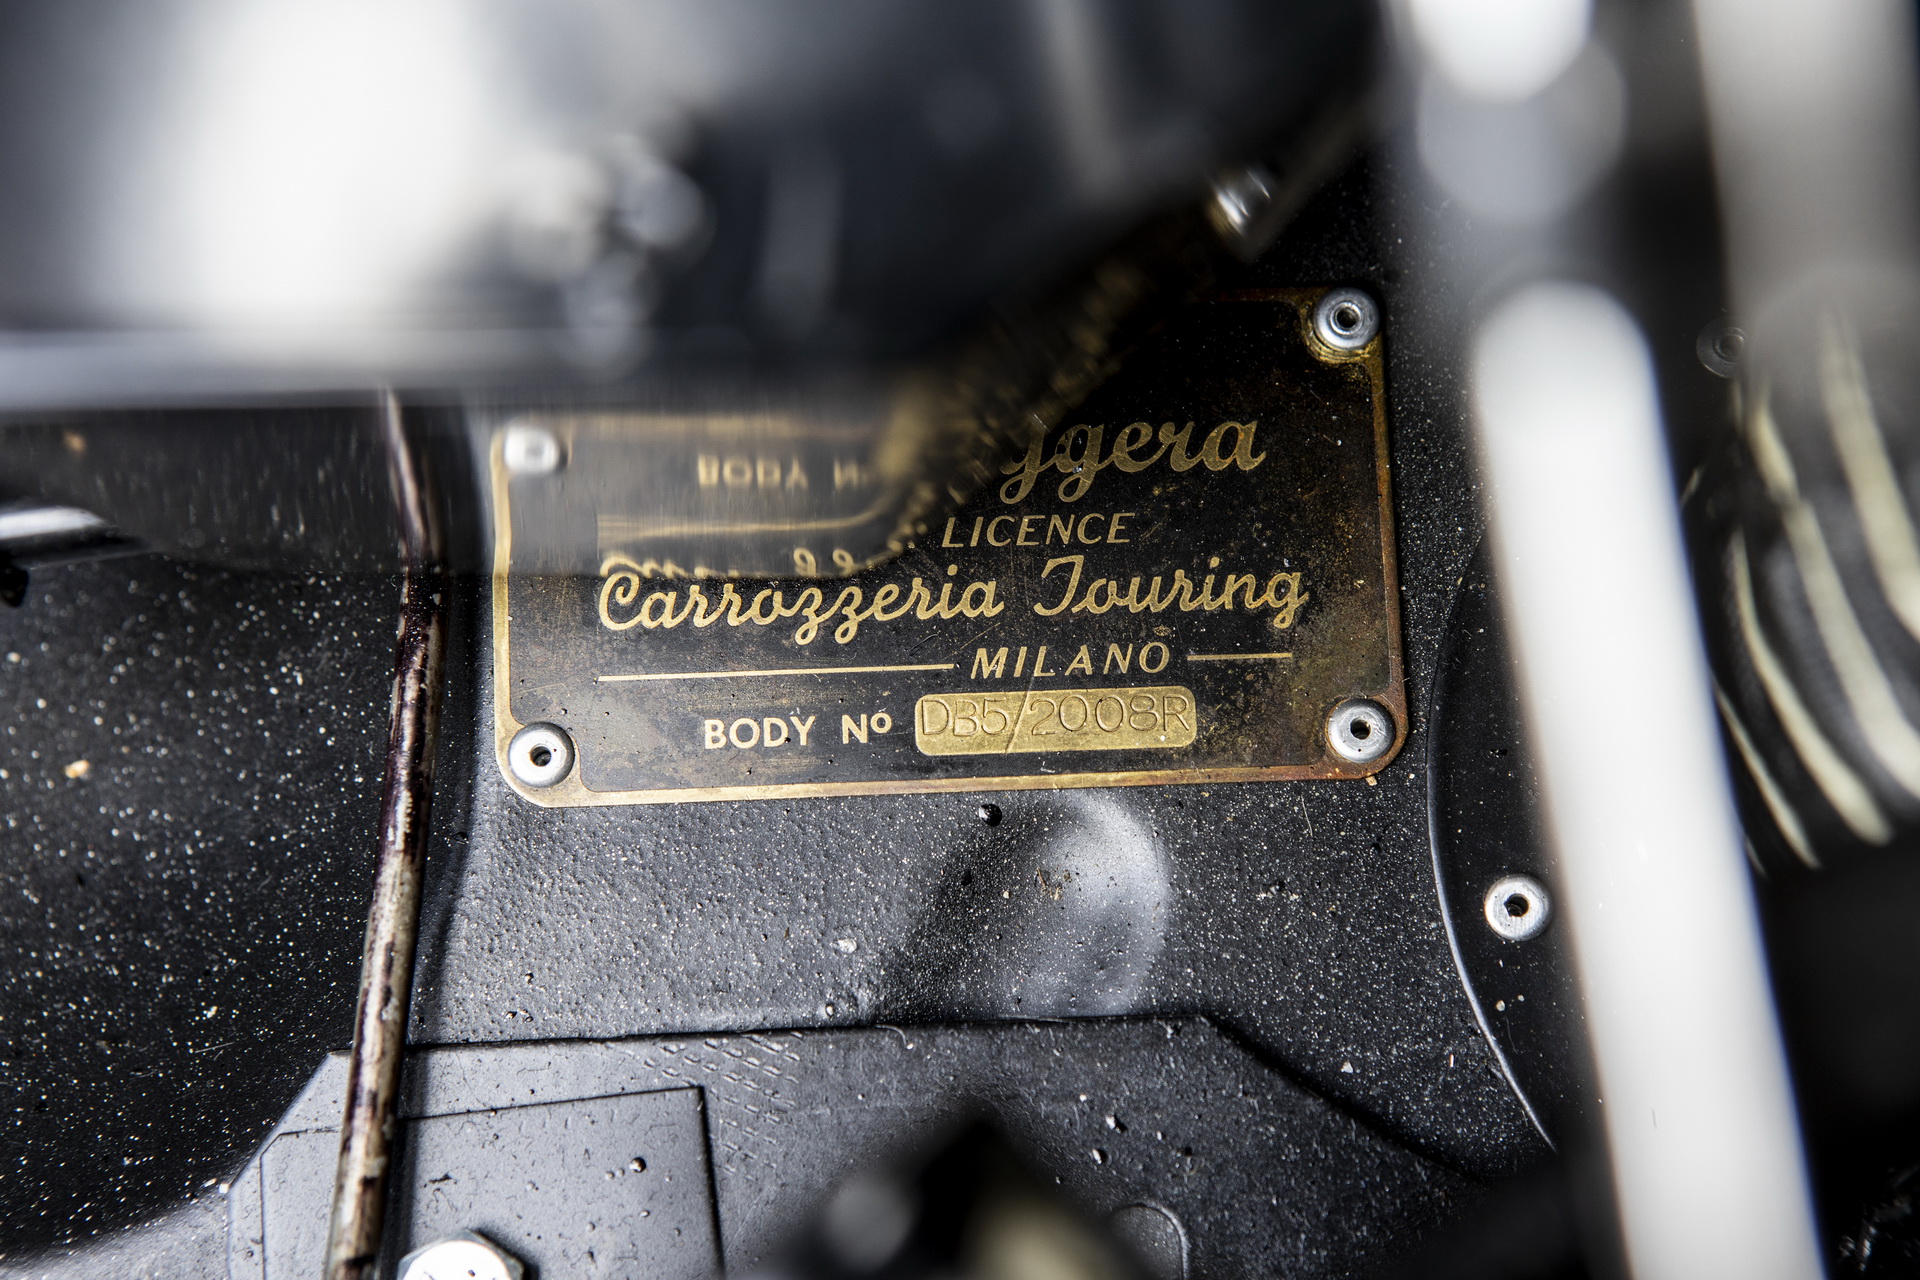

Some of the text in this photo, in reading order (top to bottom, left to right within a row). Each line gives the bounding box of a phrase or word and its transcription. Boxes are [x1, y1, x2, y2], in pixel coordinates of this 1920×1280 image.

[941, 512, 1136, 548] LICENCE
[598, 554, 1310, 646] Carrozzeria Touring
[970, 641, 1170, 680] MILANO
[703, 715, 816, 750] BODY
[920, 692, 1190, 756] DB5/2008R
